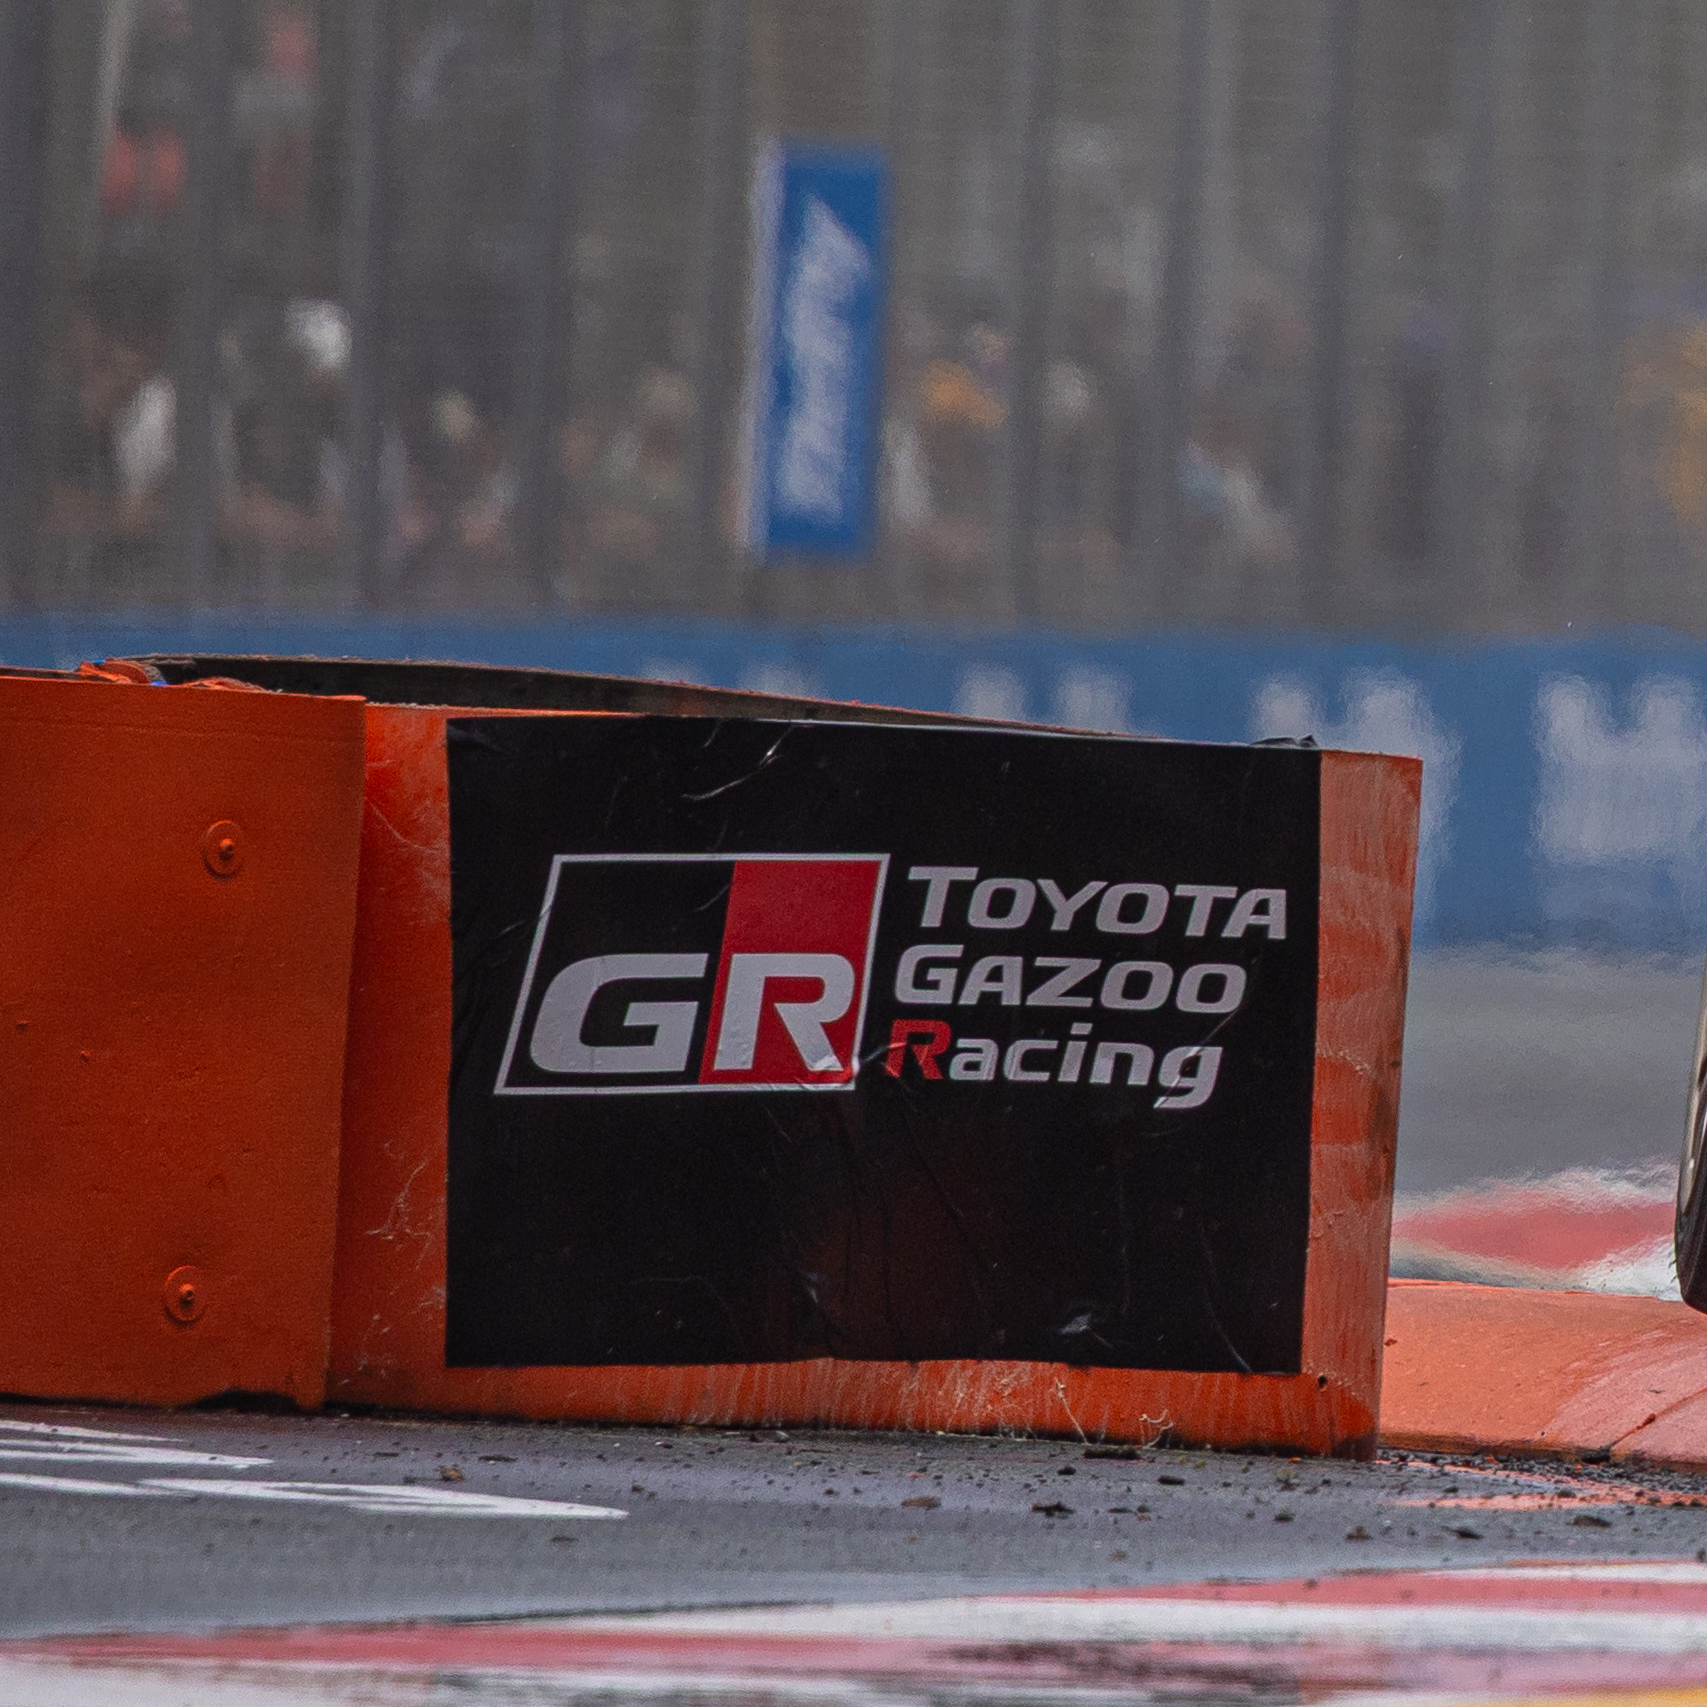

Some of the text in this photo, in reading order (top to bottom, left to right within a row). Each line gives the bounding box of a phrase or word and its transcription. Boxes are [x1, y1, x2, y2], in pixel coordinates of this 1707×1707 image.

[905, 865, 1289, 941] TOYOTA
[529, 950, 858, 1076] GR
[894, 944, 1248, 1016] GAZOO
[884, 1017, 1225, 1110] Racing
